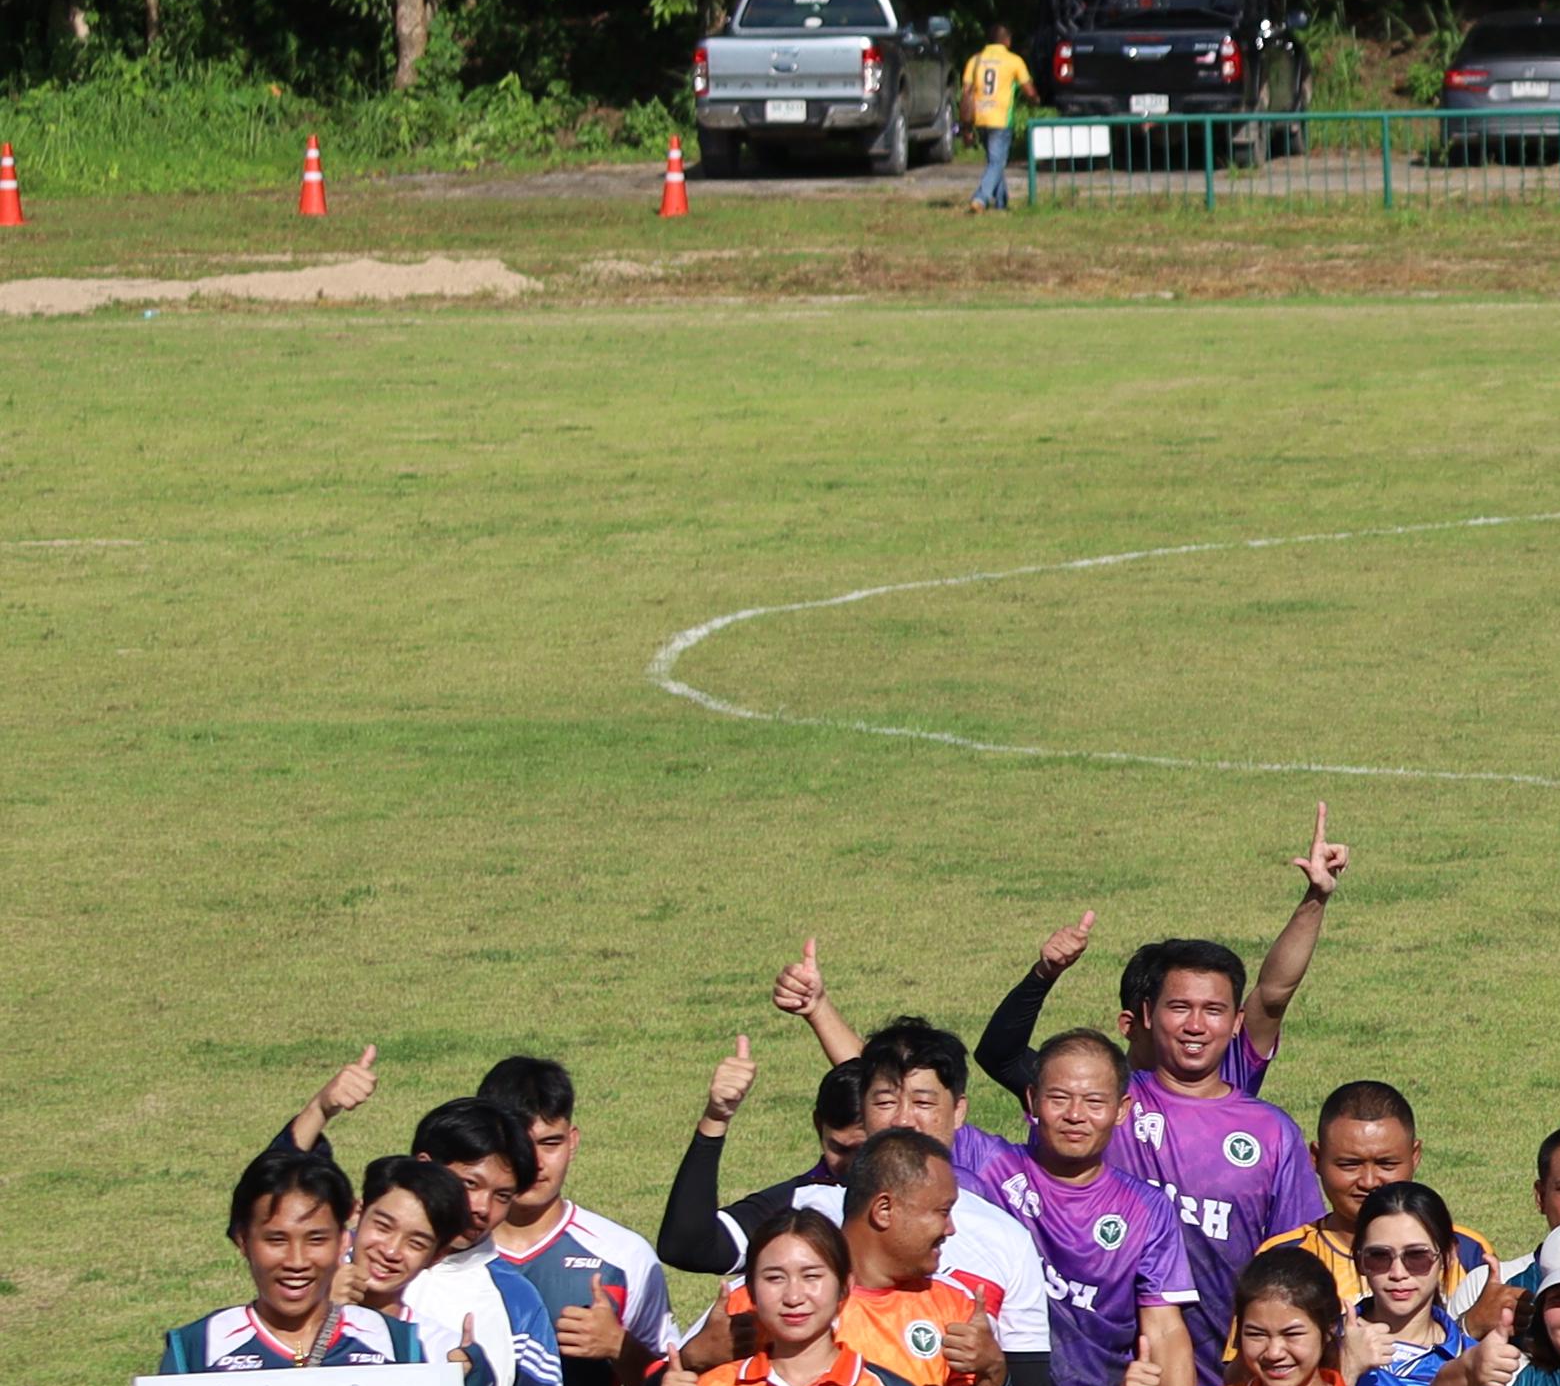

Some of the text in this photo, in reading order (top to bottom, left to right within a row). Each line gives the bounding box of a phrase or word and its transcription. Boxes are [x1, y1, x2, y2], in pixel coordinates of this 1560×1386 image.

[984, 69, 996, 94] 9
[563, 1256, 603, 1270] TSW
[349, 1353, 386, 1364] TSW
